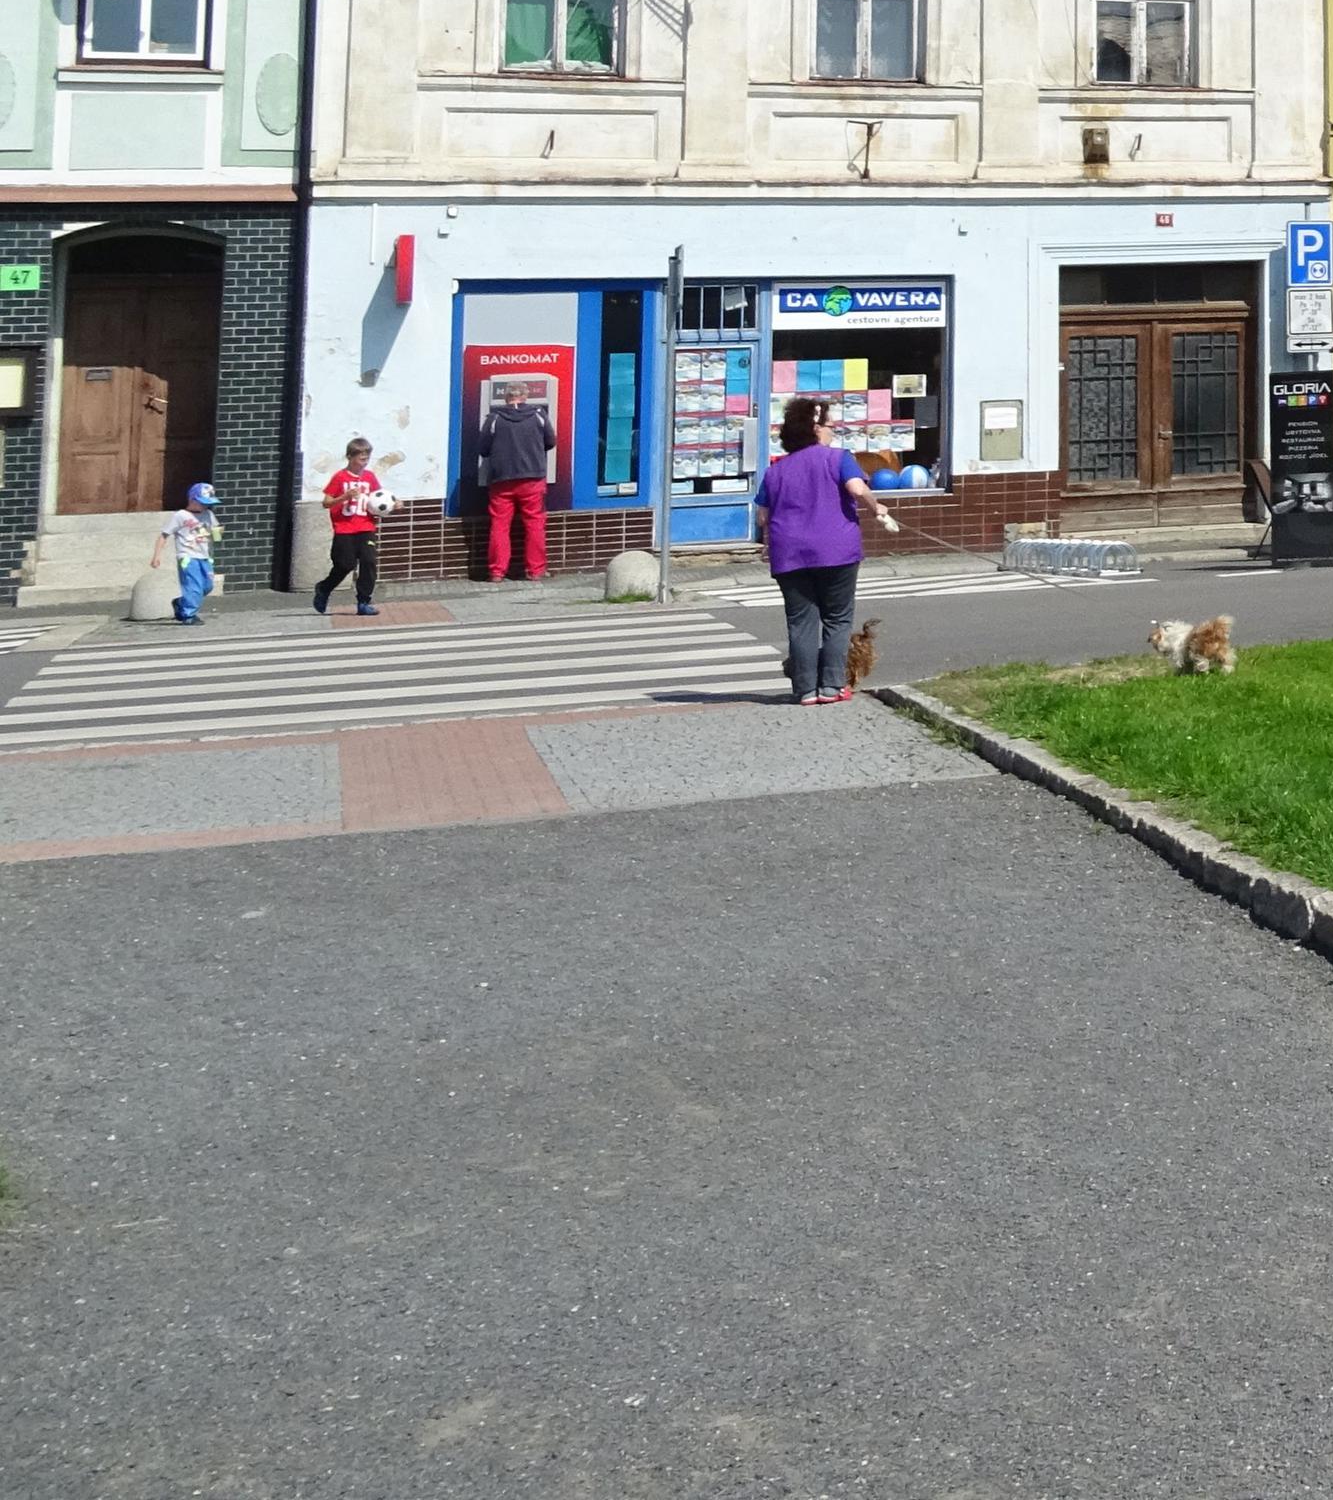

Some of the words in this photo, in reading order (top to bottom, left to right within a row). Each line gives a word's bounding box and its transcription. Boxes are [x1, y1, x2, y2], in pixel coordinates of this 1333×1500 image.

[1297, 229, 1324, 267] P
[9, 270, 31, 284] 47
[786, 292, 818, 308] CA
[855, 291, 941, 307] VAVERA
[894, 315, 940, 325] agentura
[480, 353, 560, 365] BANKOMAT
[1273, 382, 1332, 395] GLORIA
